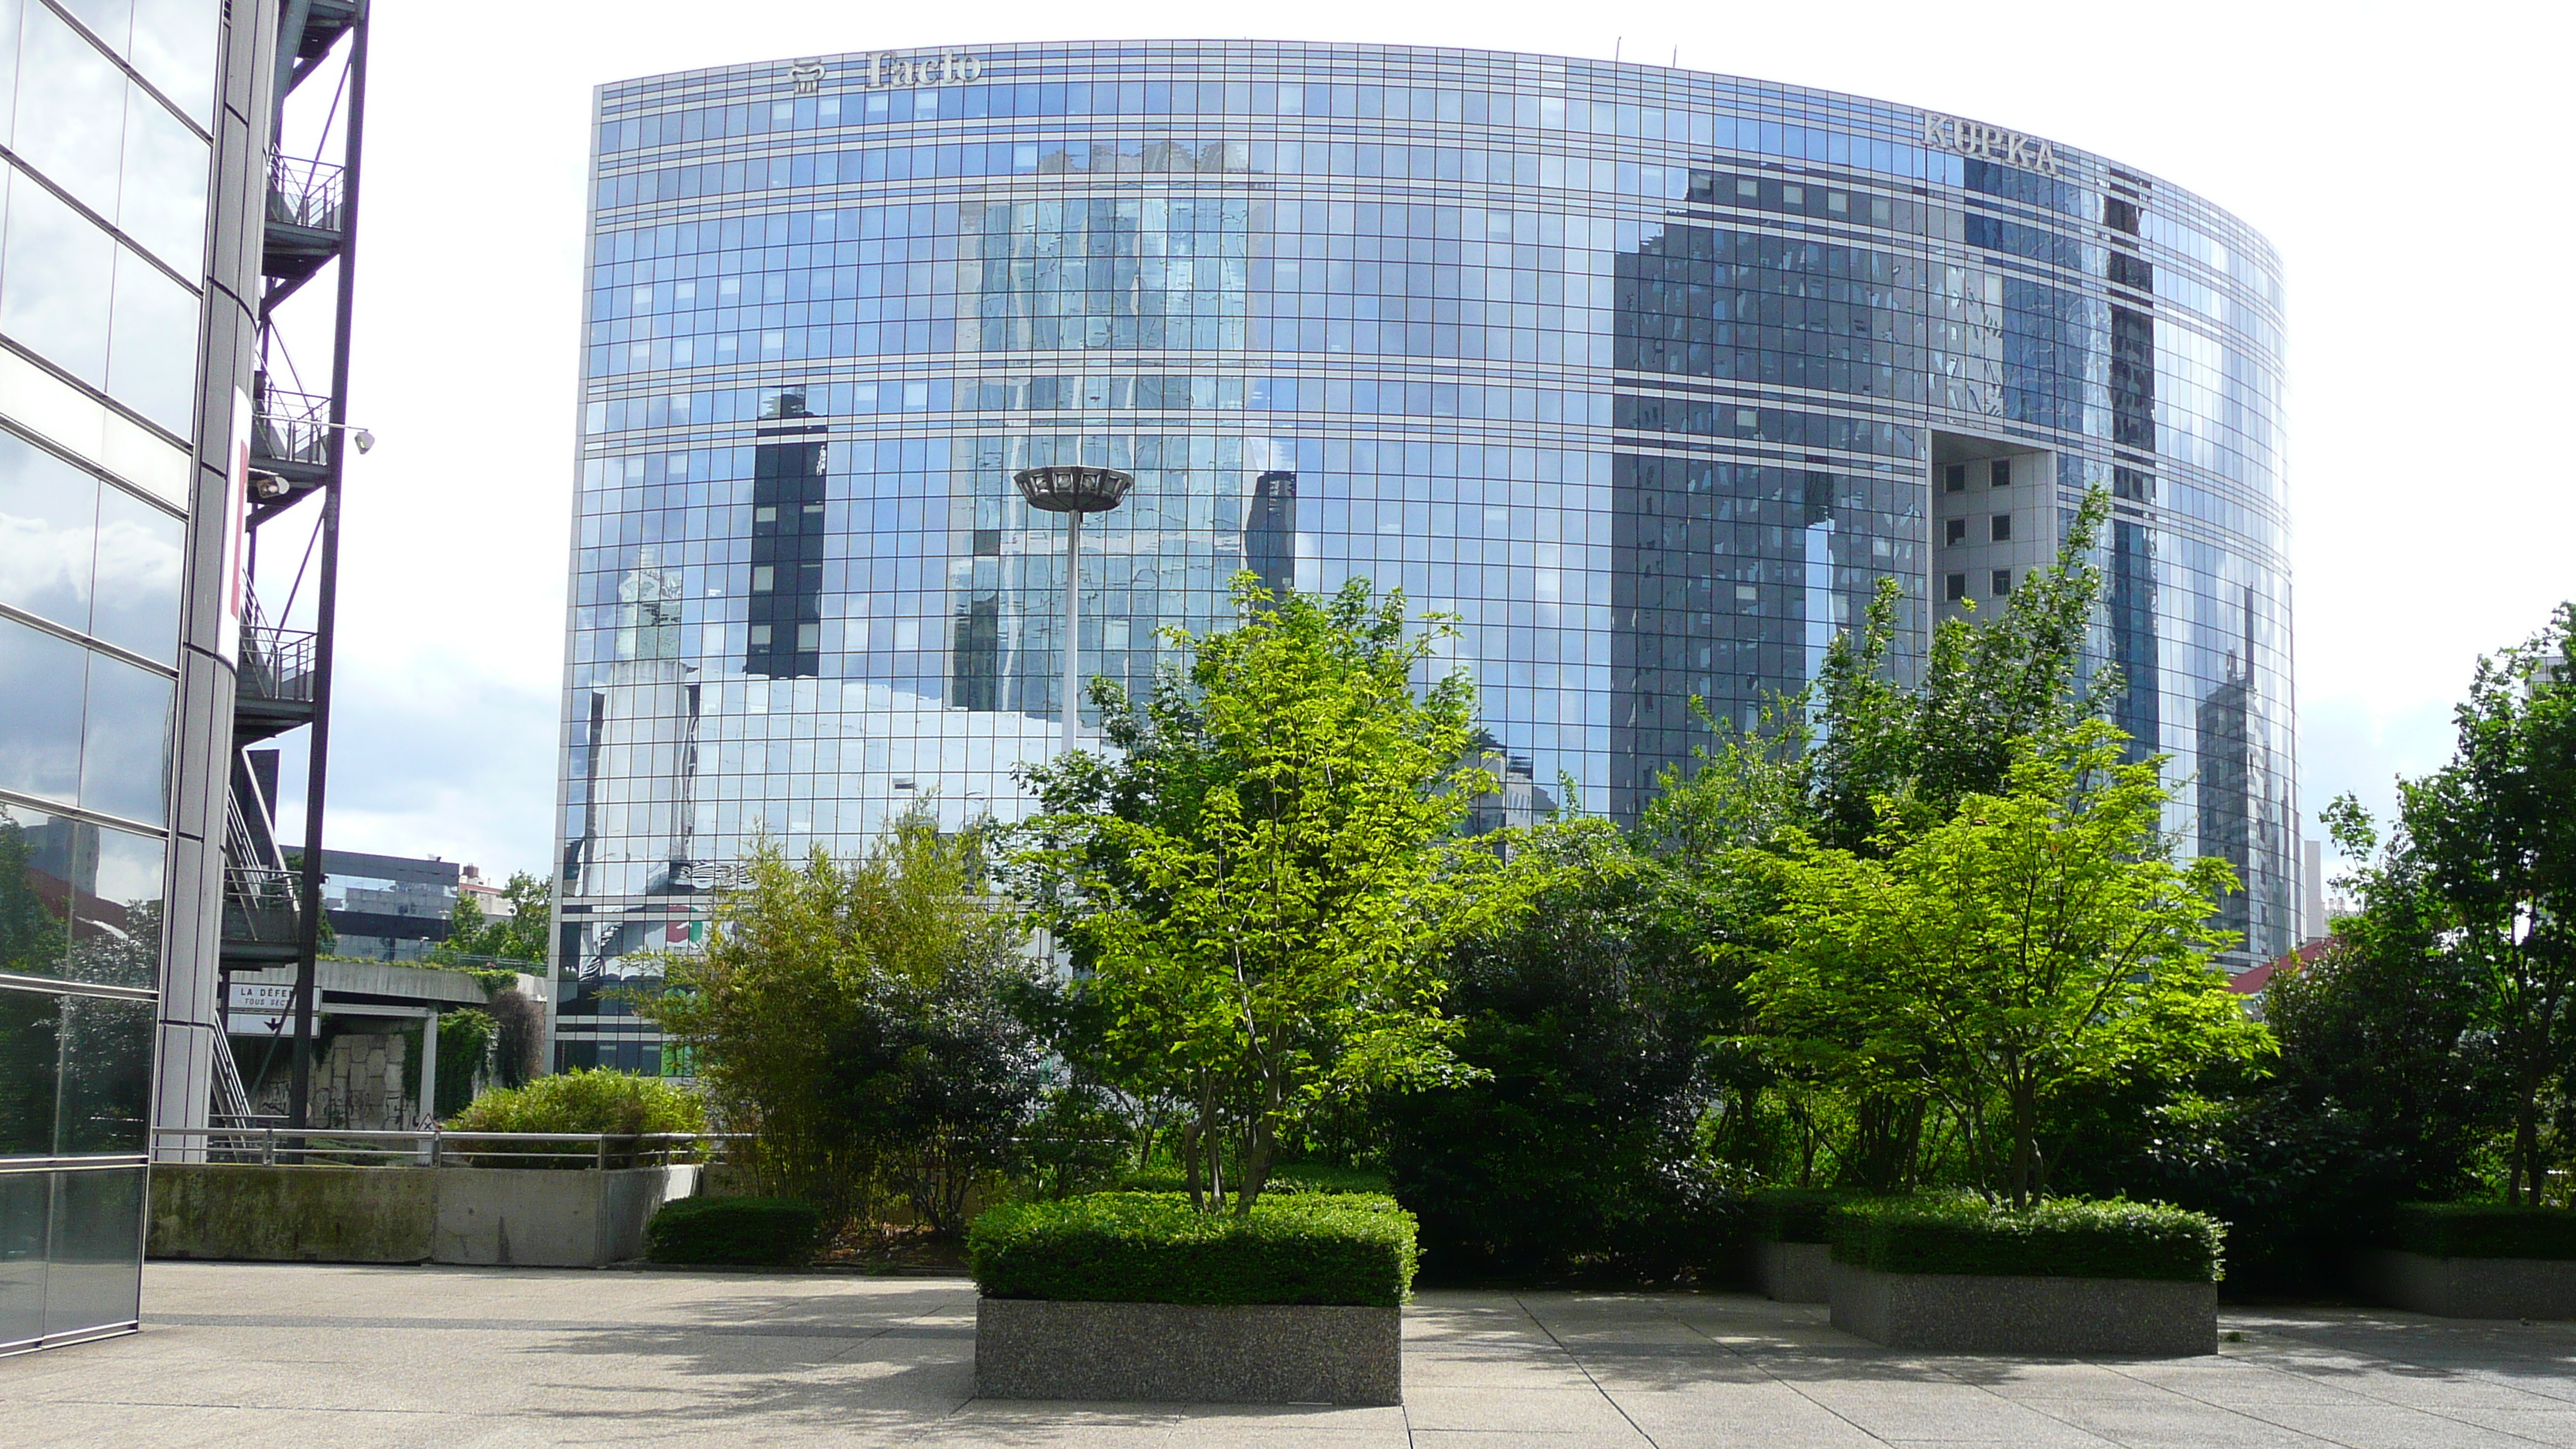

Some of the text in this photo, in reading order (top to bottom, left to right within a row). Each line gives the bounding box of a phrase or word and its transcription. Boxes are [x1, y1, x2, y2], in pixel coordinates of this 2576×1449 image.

[865, 49, 981, 88] Facto
[1921, 111, 2059, 176] KUPKA
[241, 988, 253, 996] LA
